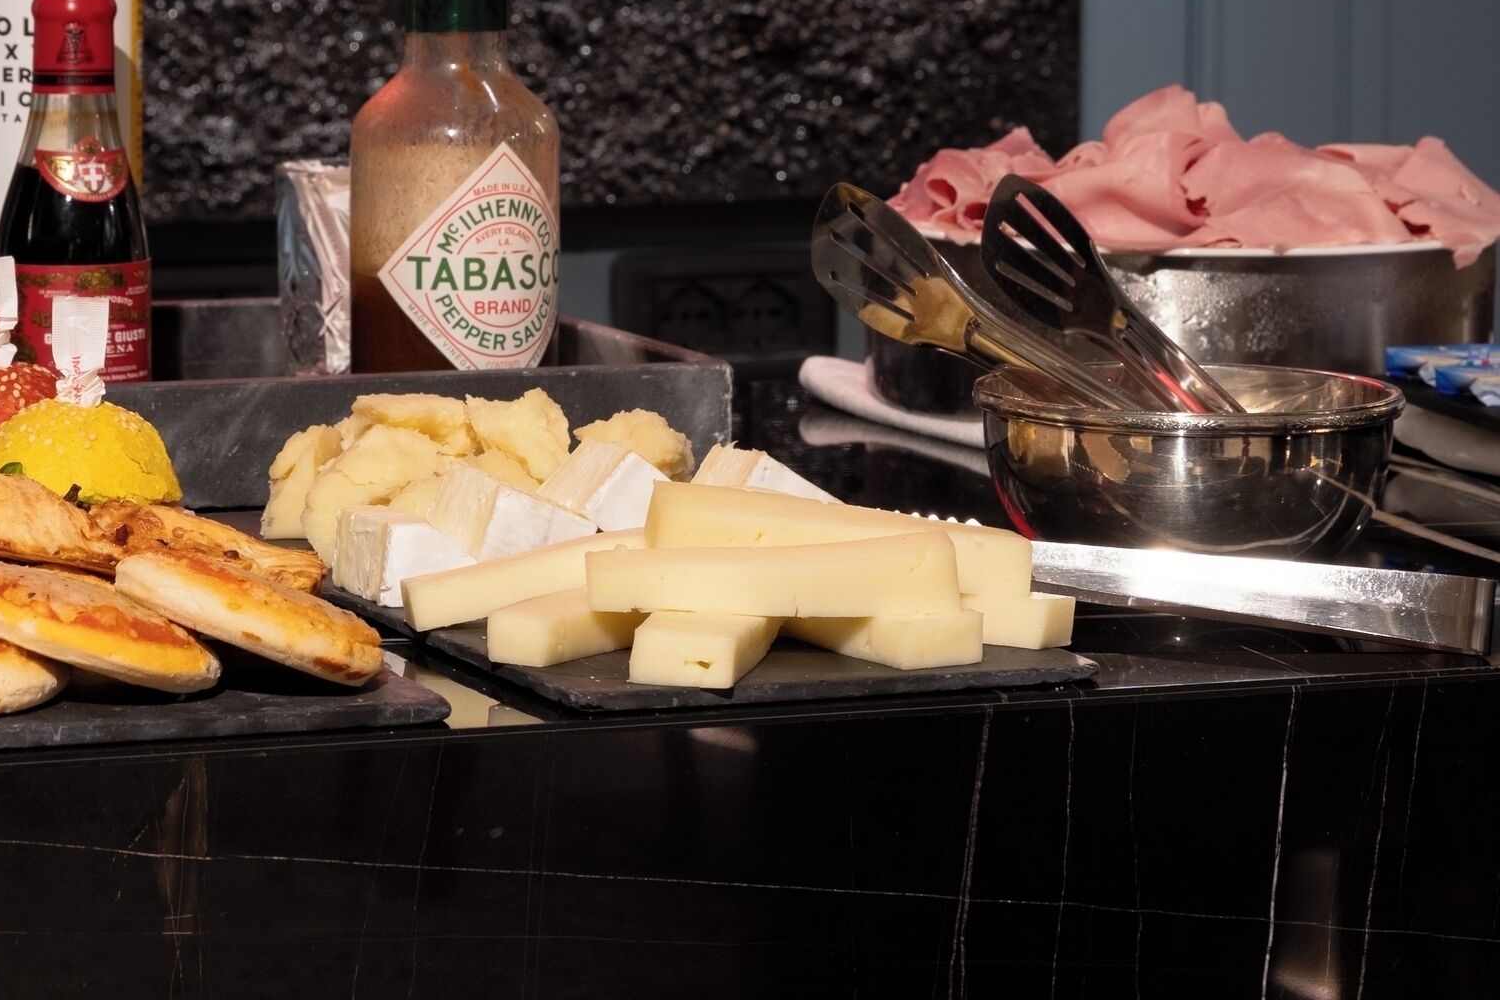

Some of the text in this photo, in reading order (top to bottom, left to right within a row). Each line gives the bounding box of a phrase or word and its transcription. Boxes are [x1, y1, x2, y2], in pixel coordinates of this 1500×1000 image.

[473, 184, 500, 196] MADE
[501, 183, 511, 191] IN
[476, 227, 531, 244] AVERY ISLAND
[474, 298, 532, 315] BRAND
[435, 294, 506, 350] PEPPER
[512, 293, 551, 348] SAUCE
[114, 328, 146, 343] GIUSTI
[106, 343, 135, 354] ENA
[442, 341, 472, 370] VINEGA
